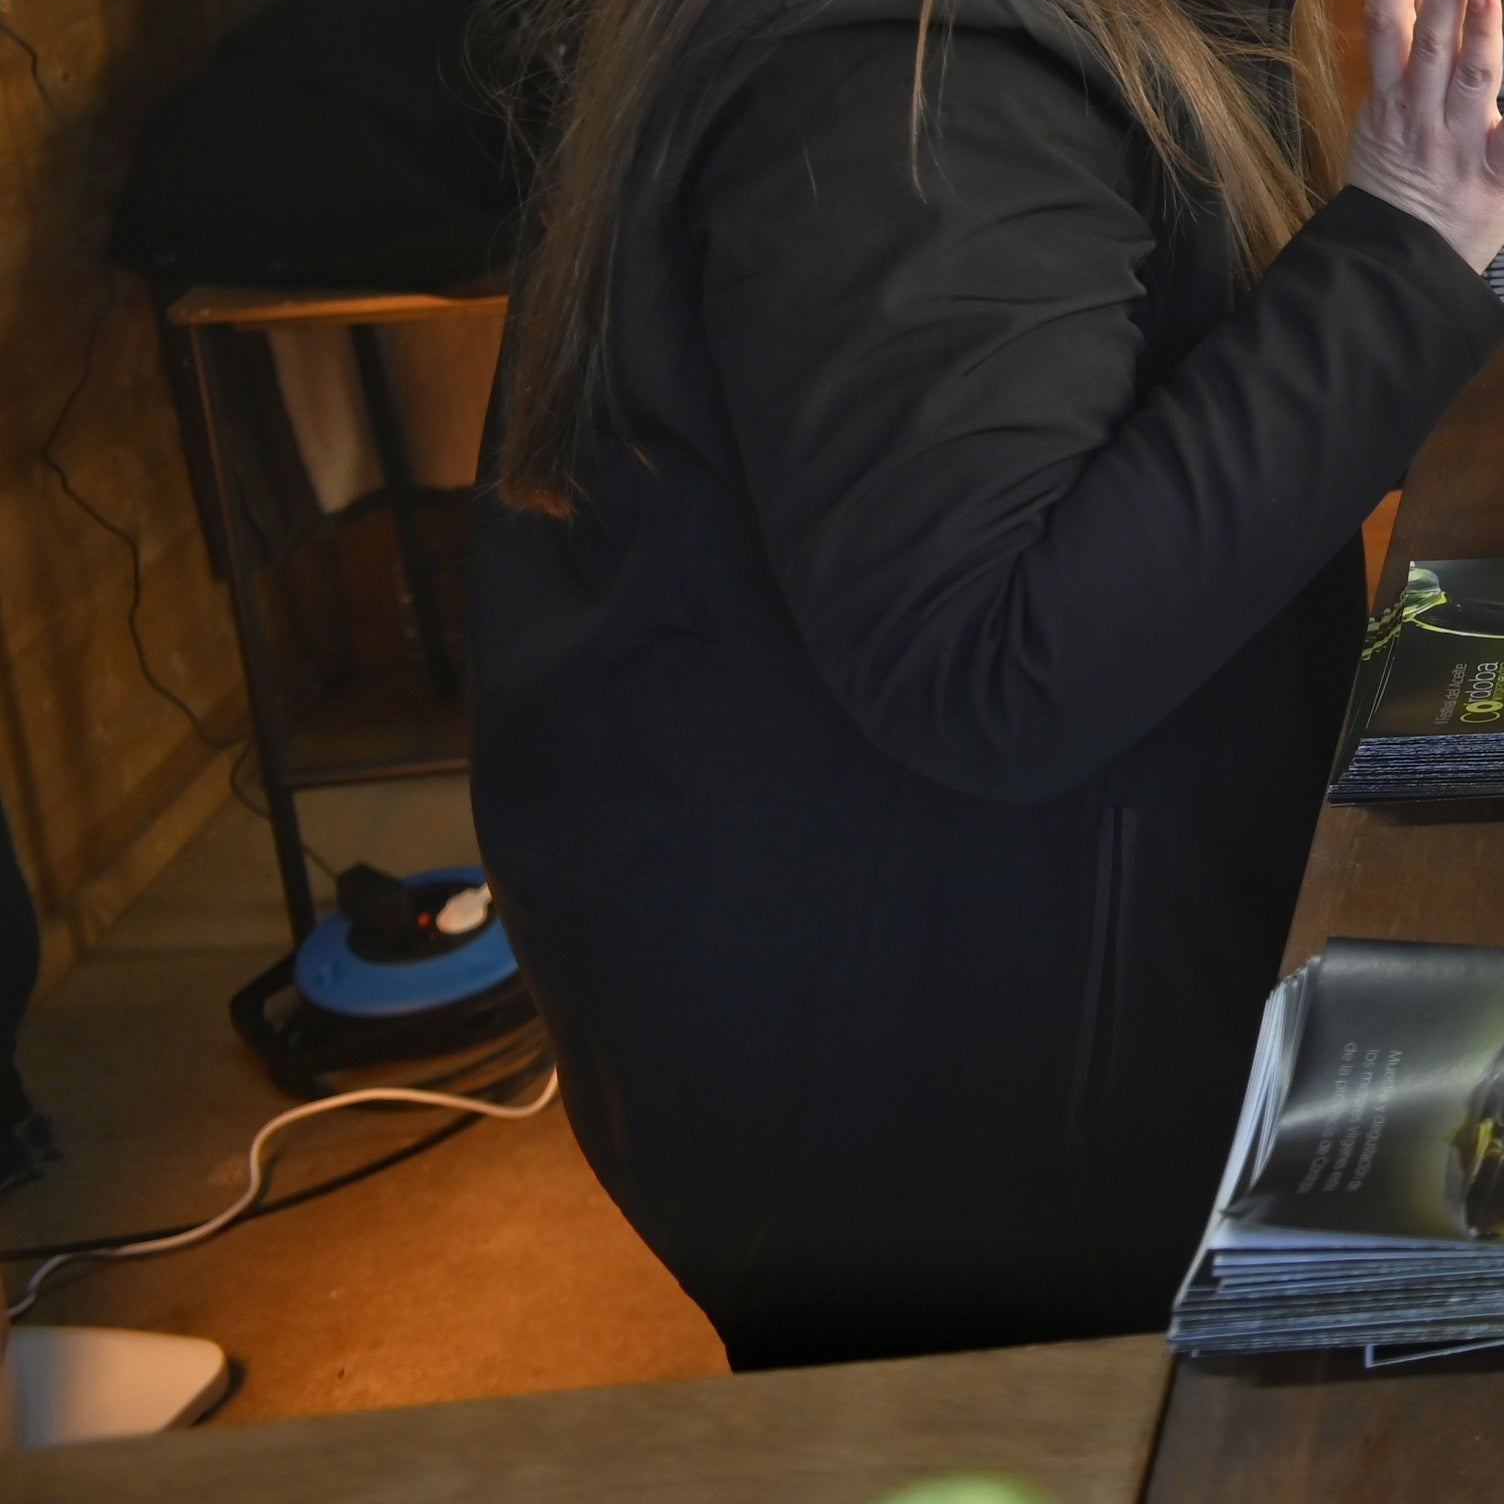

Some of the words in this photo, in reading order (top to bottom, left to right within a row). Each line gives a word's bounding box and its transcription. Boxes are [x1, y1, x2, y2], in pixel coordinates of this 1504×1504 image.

[1460, 661, 1504, 724] Córdoba
[1343, 1042, 1357, 1062] de
[1363, 1049, 1380, 1068] los
[1339, 1065, 1354, 1076] la
